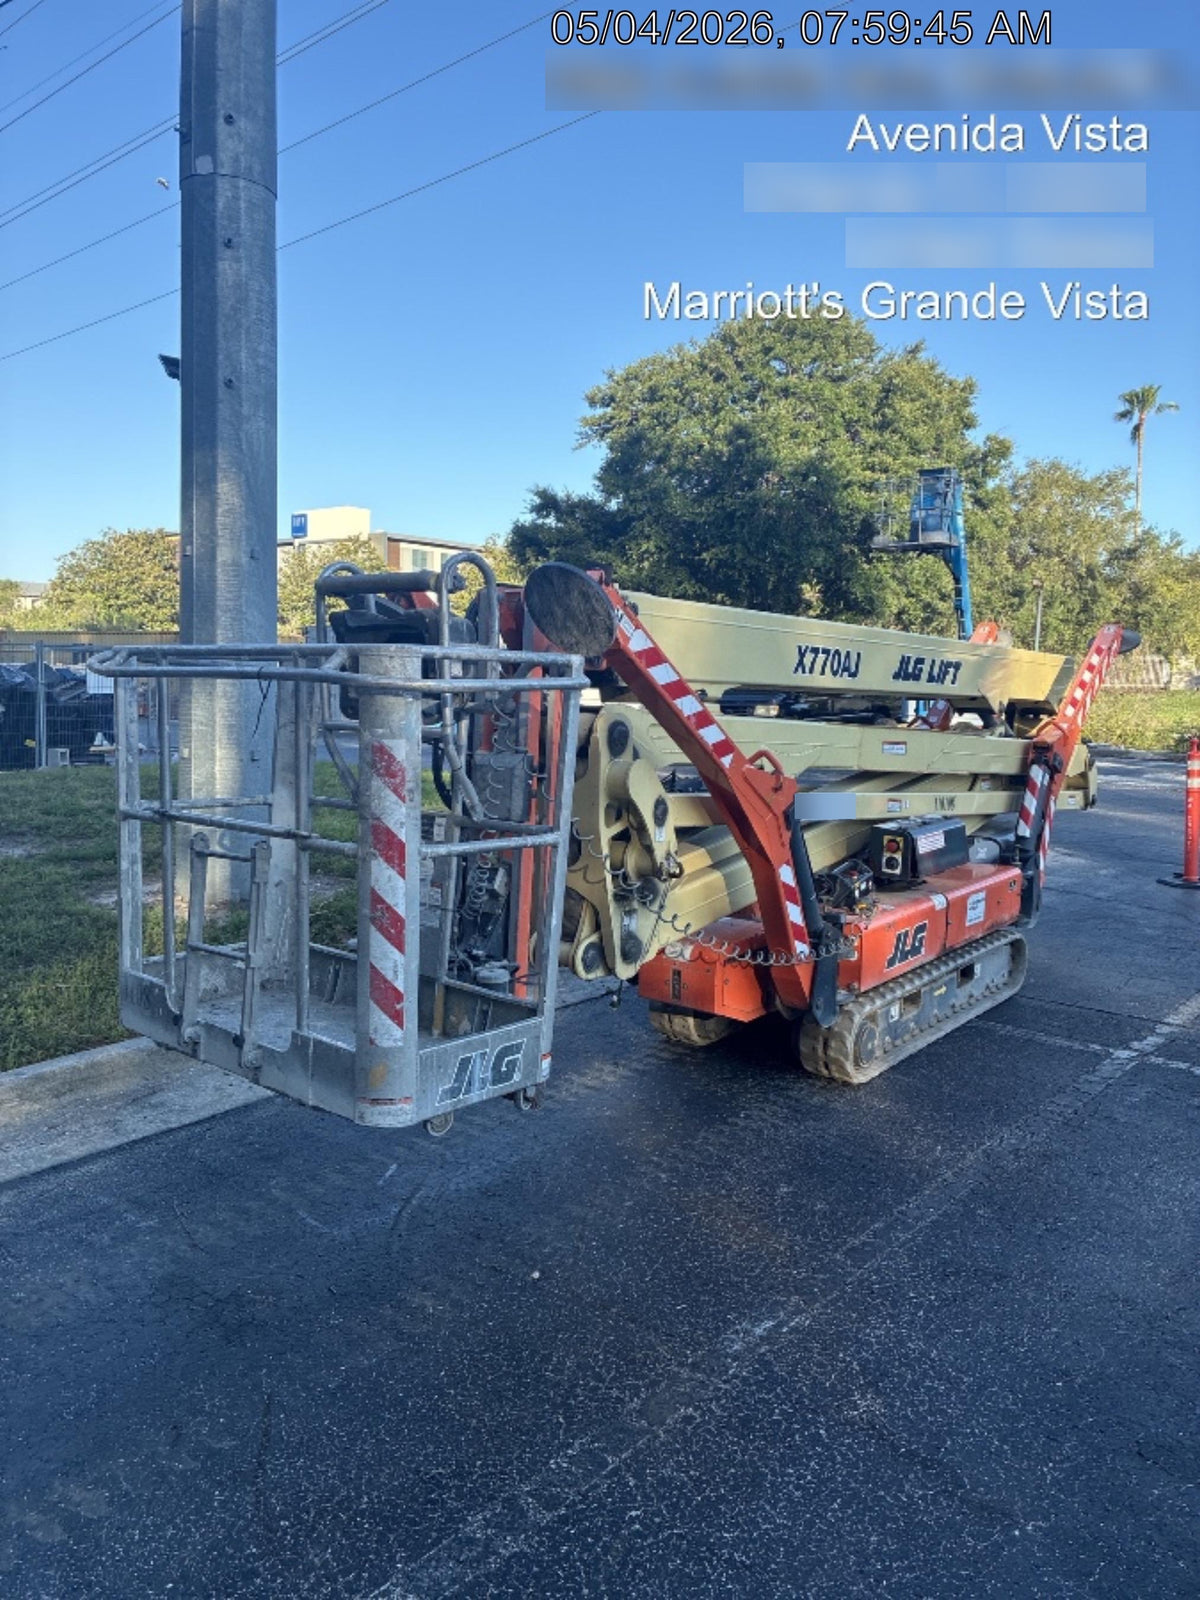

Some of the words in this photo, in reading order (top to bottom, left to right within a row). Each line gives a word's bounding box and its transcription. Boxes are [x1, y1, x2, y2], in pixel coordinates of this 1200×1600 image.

[793, 644, 862, 678] X770AJ
[892, 654, 926, 682] JLG
[926, 657, 963, 685] LIFT
[885, 920, 928, 972] JLG
[436, 1038, 526, 1105] JLG
